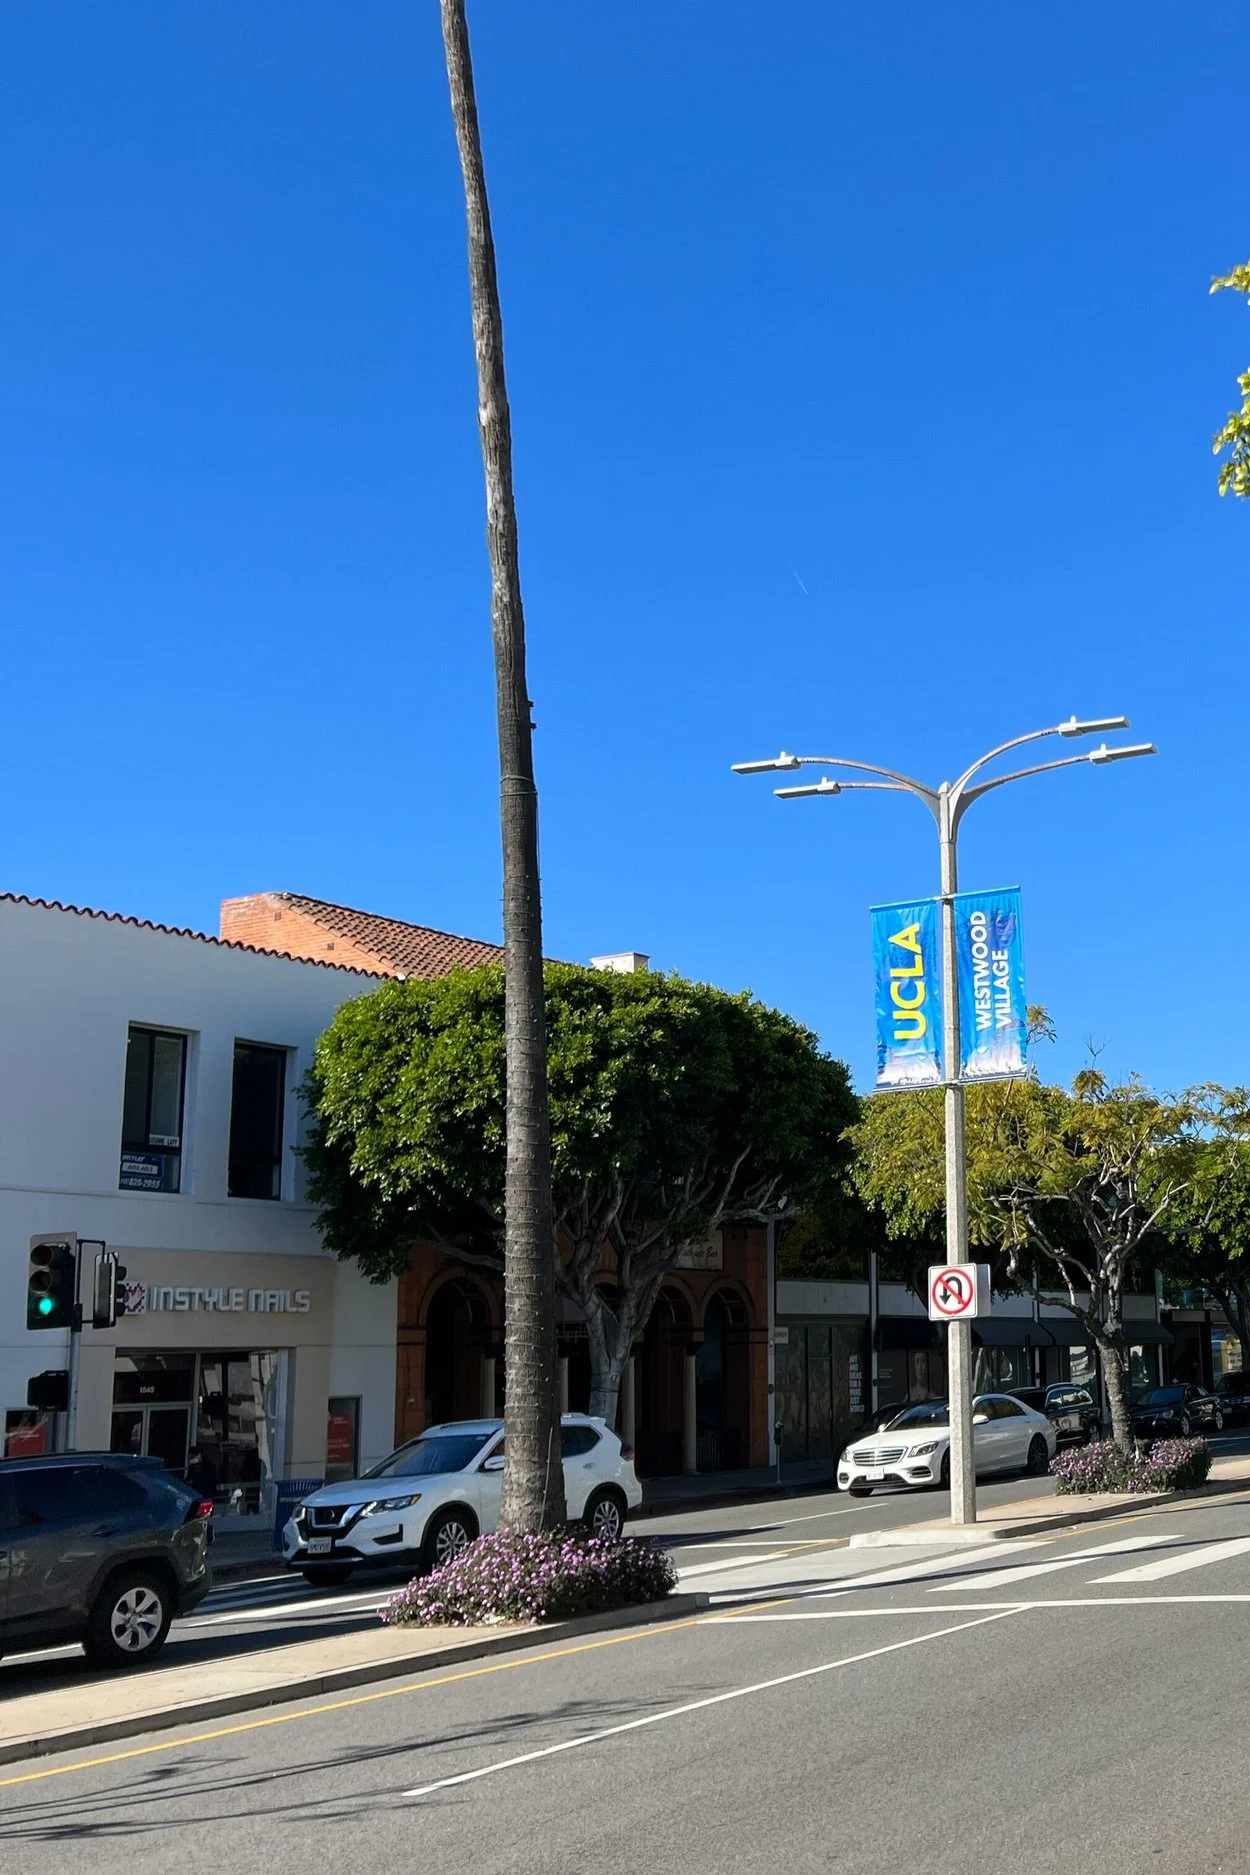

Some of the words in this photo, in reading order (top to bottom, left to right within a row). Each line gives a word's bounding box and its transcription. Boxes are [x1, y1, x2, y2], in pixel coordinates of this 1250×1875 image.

[888, 922, 927, 1040] UCLA
[968, 911, 992, 1031] WESTWOOD
[992, 950, 1012, 1029] VILLAGE
[150, 1286, 244, 1311] INSTYLE
[248, 1289, 311, 1313] NAILS
